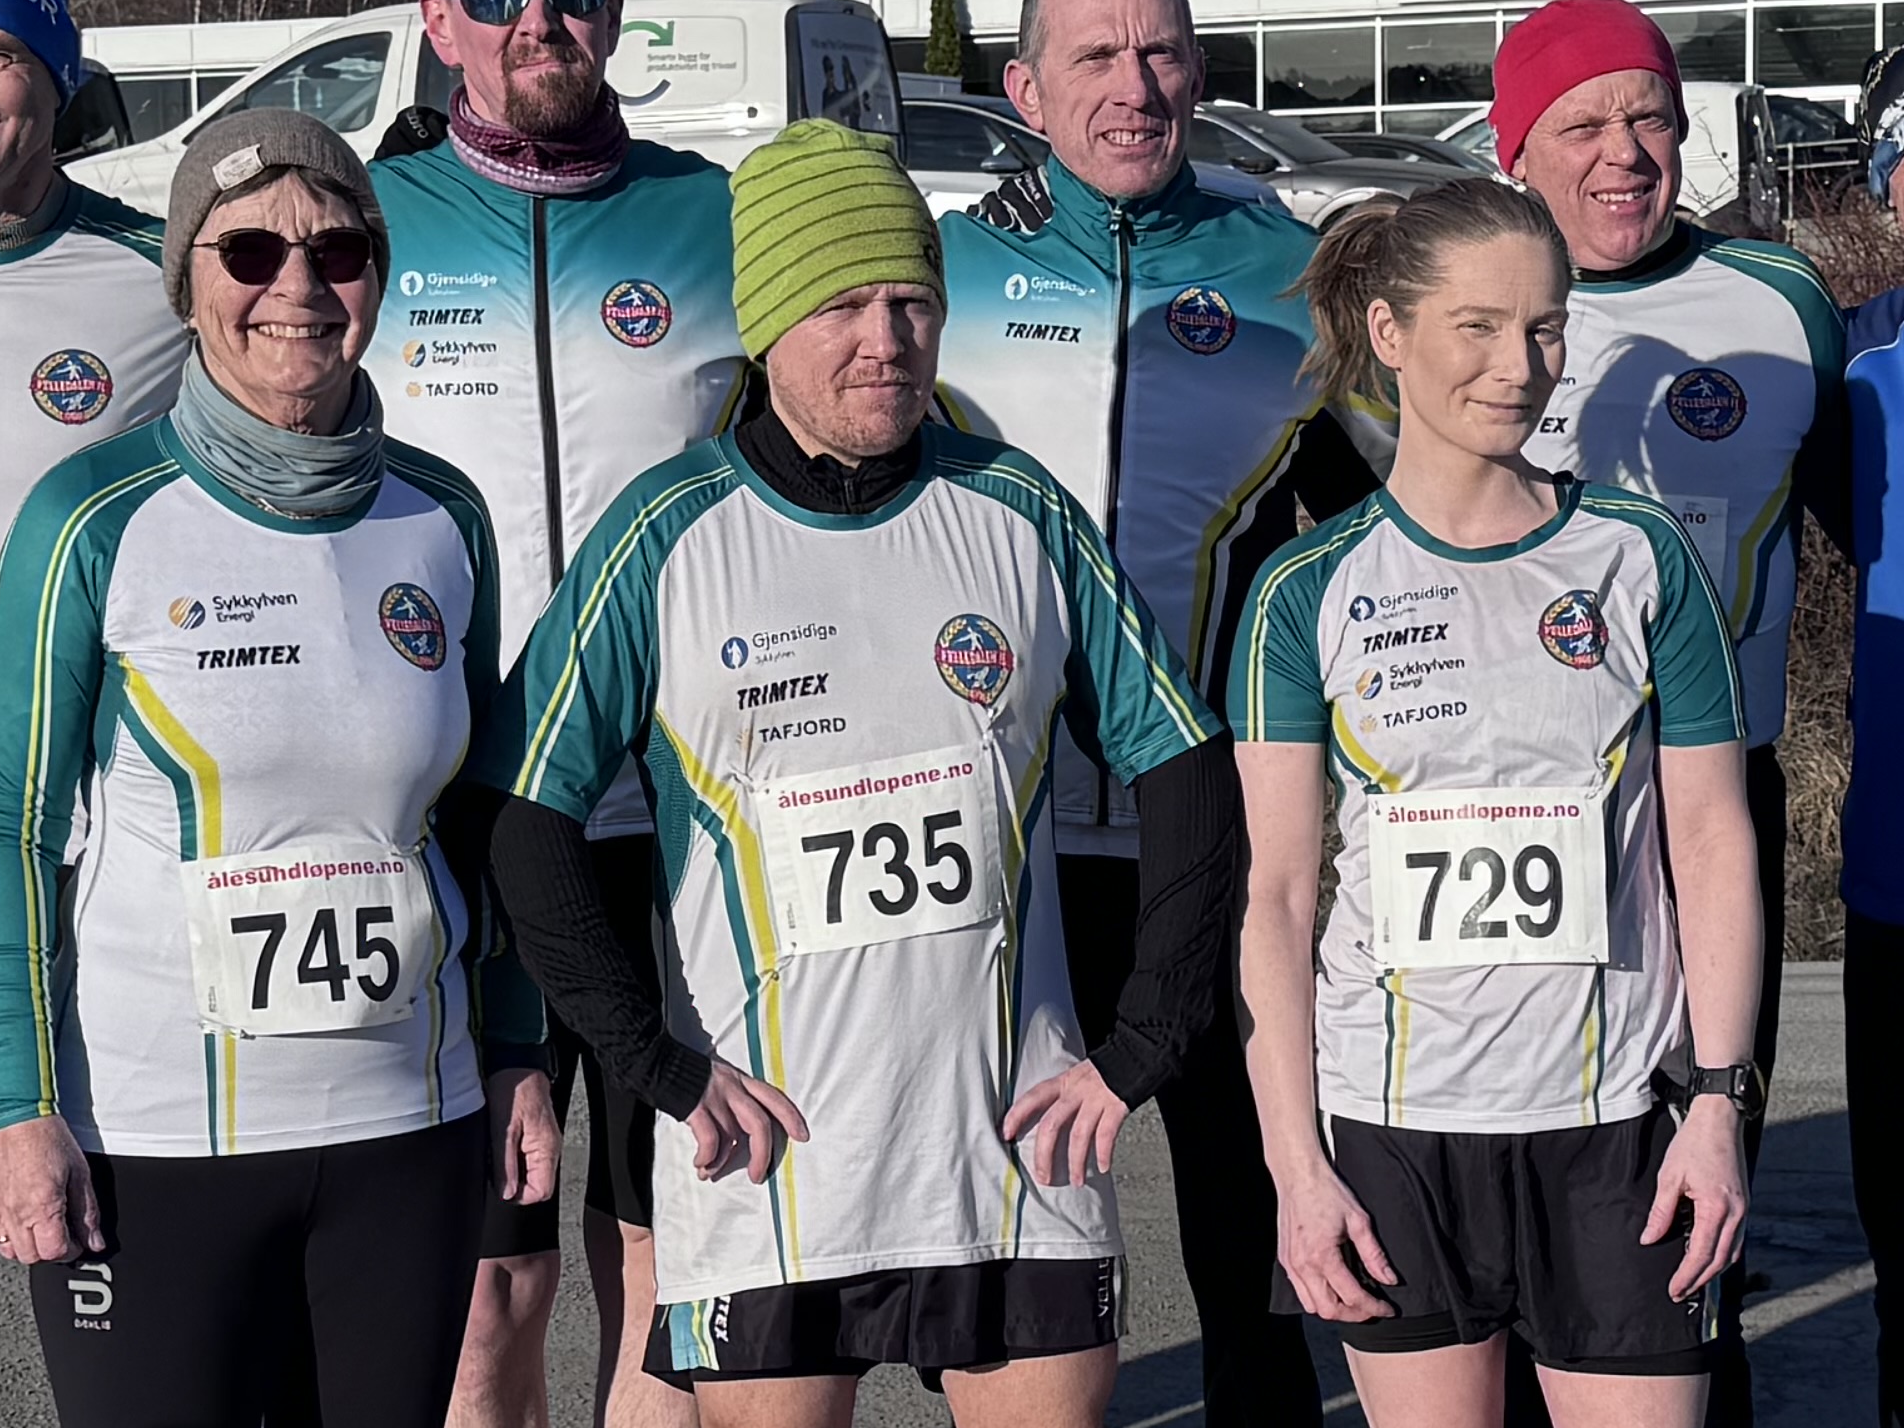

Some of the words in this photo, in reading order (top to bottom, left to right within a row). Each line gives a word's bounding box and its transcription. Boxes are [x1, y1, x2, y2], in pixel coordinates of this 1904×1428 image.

[409, 309, 486, 327] TRIMTEX
[1005, 322, 1082, 344] TRIMTEX
[426, 382, 499, 397] TAFJORD
[212, 592, 298, 612] Sykkylven
[752, 623, 838, 649] Gjensidige
[1362, 623, 1449, 654] TRIMTEX
[196, 645, 301, 670] TRIMTEX
[737, 673, 829, 710] TRIMTEX
[1383, 701, 1467, 728] TAFJORD
[759, 717, 846, 743] TAFJORD
[778, 762, 974, 809] ålesundløpene.no
[207, 861, 405, 889] ålesundløpene.no
[801, 809, 973, 924] 735
[1406, 844, 1563, 941] 729
[230, 906, 400, 1010] 745
